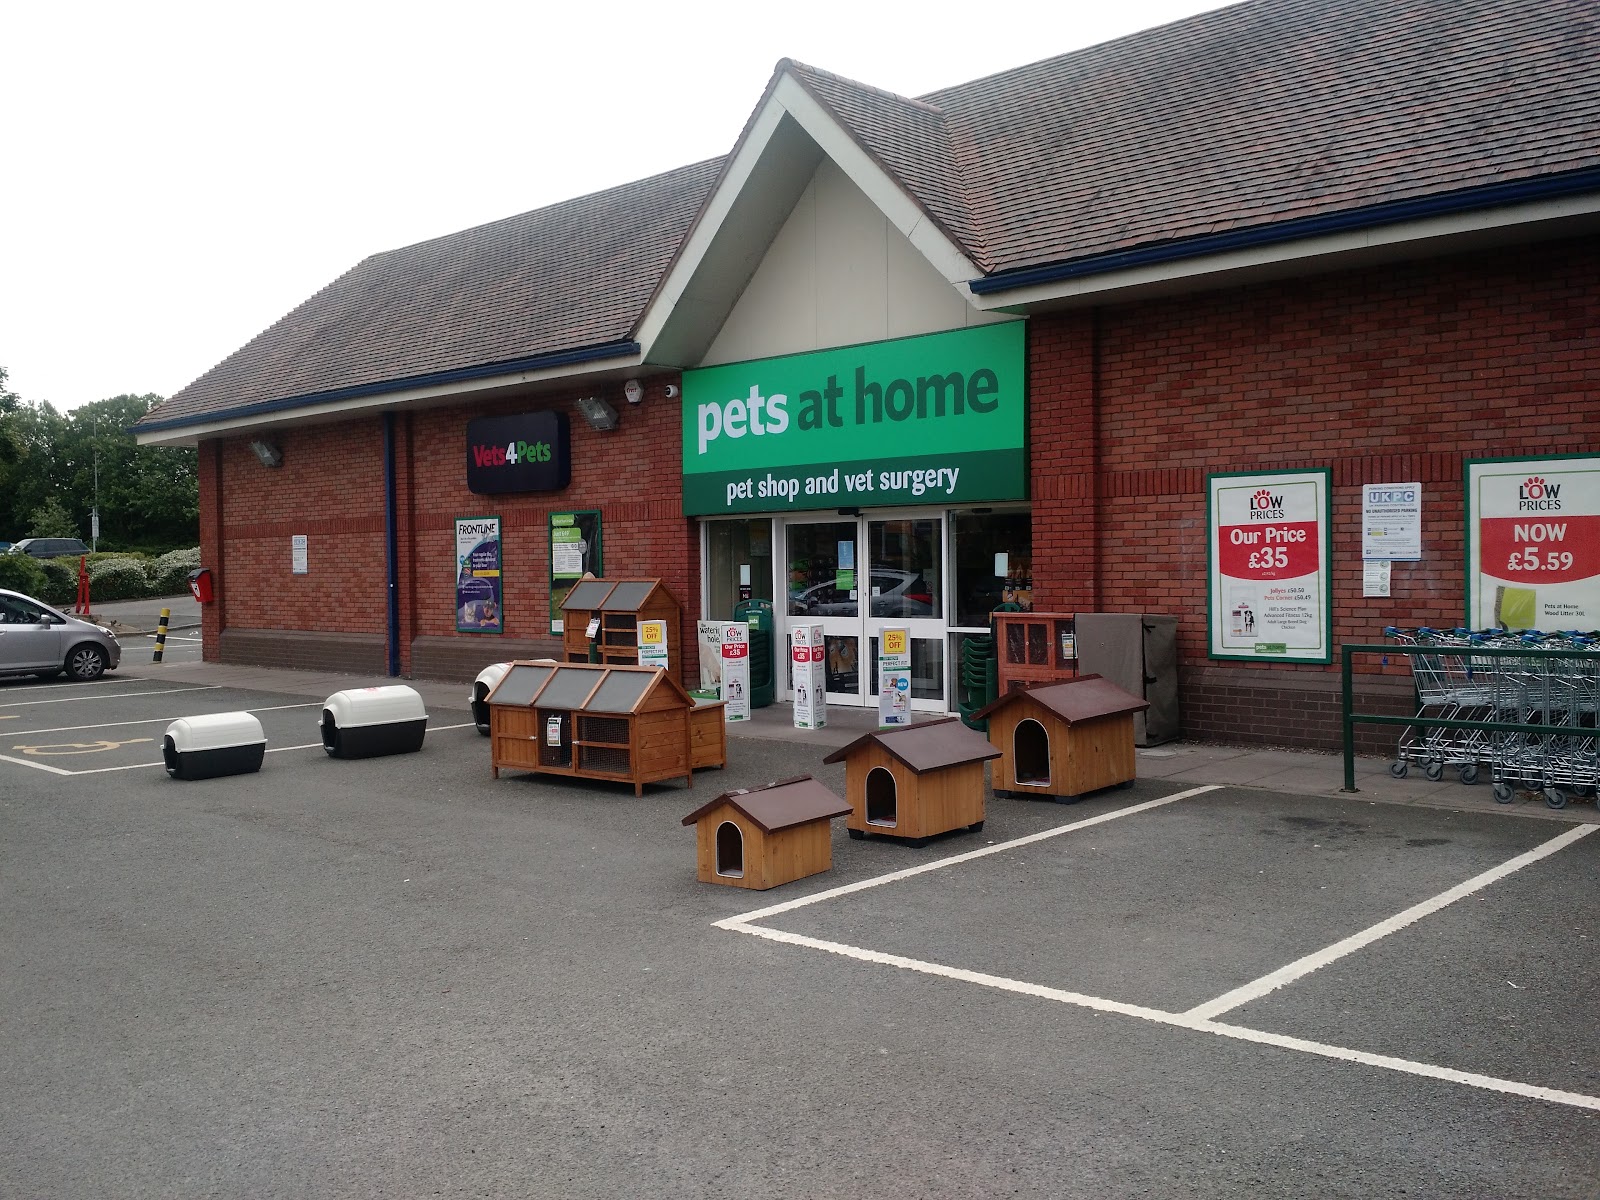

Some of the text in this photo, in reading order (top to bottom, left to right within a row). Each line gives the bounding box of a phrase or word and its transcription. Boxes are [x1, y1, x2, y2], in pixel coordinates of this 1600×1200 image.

[698, 365, 999, 455] pets at home
[473, 440, 552, 467] Vets4Pets
[727, 467, 959, 505] pet shop and vet surgery
[1519, 484, 1561, 500] LOW
[1250, 495, 1283, 510] LOW
[1369, 491, 1415, 503] UKPC
[1519, 499, 1561, 511] PRICES
[1250, 509, 1285, 520] PRICES
[459, 523, 496, 535] FRONTLINE
[1230, 527, 1307, 545] Our Price
[1514, 523, 1567, 543] NOW
[1248, 546, 1289, 569] £35
[1507, 547, 1574, 571] £5.59
[888, 641, 902, 649] OFF
